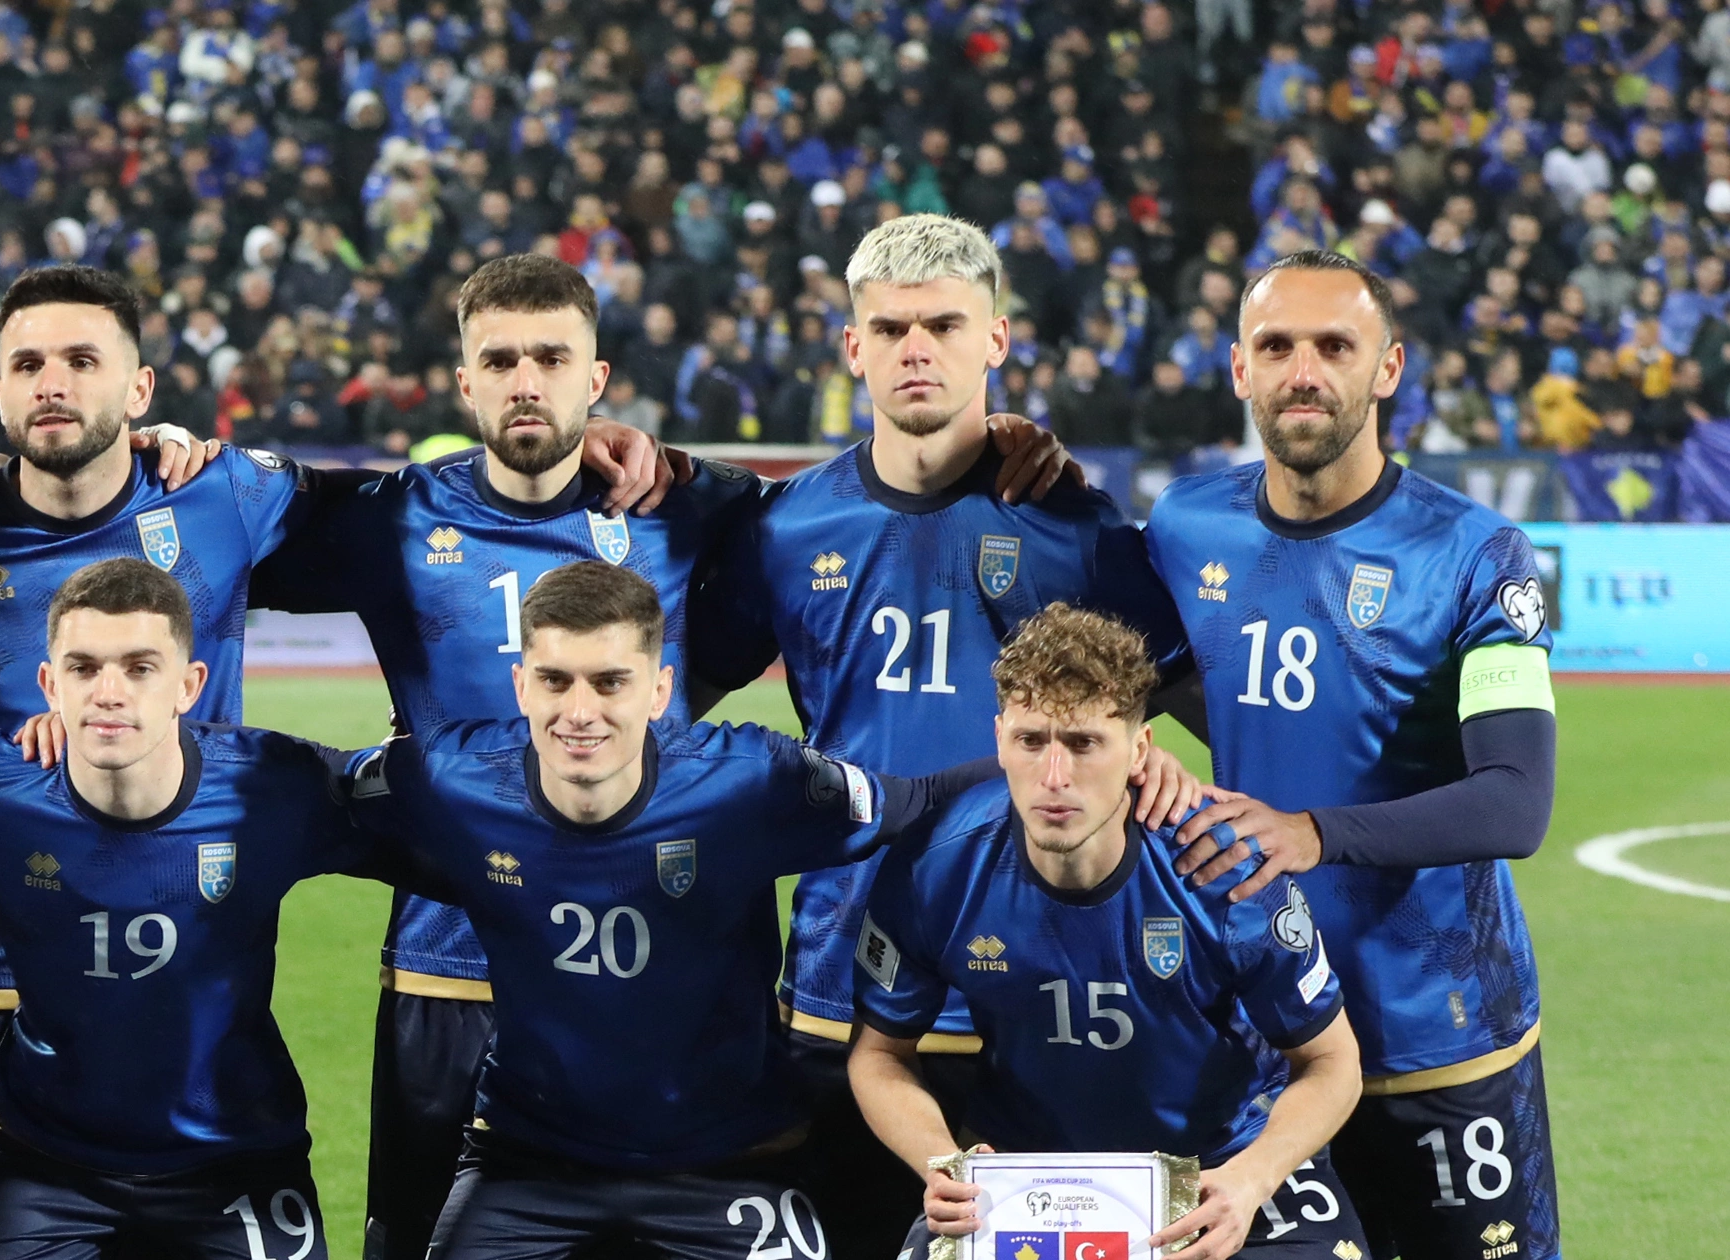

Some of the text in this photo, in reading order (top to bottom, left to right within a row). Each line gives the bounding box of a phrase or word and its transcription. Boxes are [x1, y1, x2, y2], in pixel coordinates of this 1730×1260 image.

[141, 514, 169, 526] KOSOVA
[986, 540, 1015, 550] KOSOVA
[427, 550, 463, 564] errea
[1358, 569, 1387, 582] KOSOVA
[812, 575, 848, 591] errea
[1198, 587, 1227, 603] errea
[871, 606, 956, 694] 21
[1237, 620, 1318, 712] 18
[203, 848, 232, 856] KOSOVA
[661, 845, 691, 854] KOSOVA
[1147, 922, 1178, 931] KOSOVA
[79, 911, 178, 980] 19
[549, 902, 650, 979] 20
[968, 959, 1008, 972] errea
[1039, 979, 1134, 1050] 15
[1417, 1116, 1512, 1208] 18
[1053, 1203, 1099, 1211] QUALIFIERS
[1053, 1220, 1082, 1228] play-offs
[1483, 1241, 1518, 1260] errea
